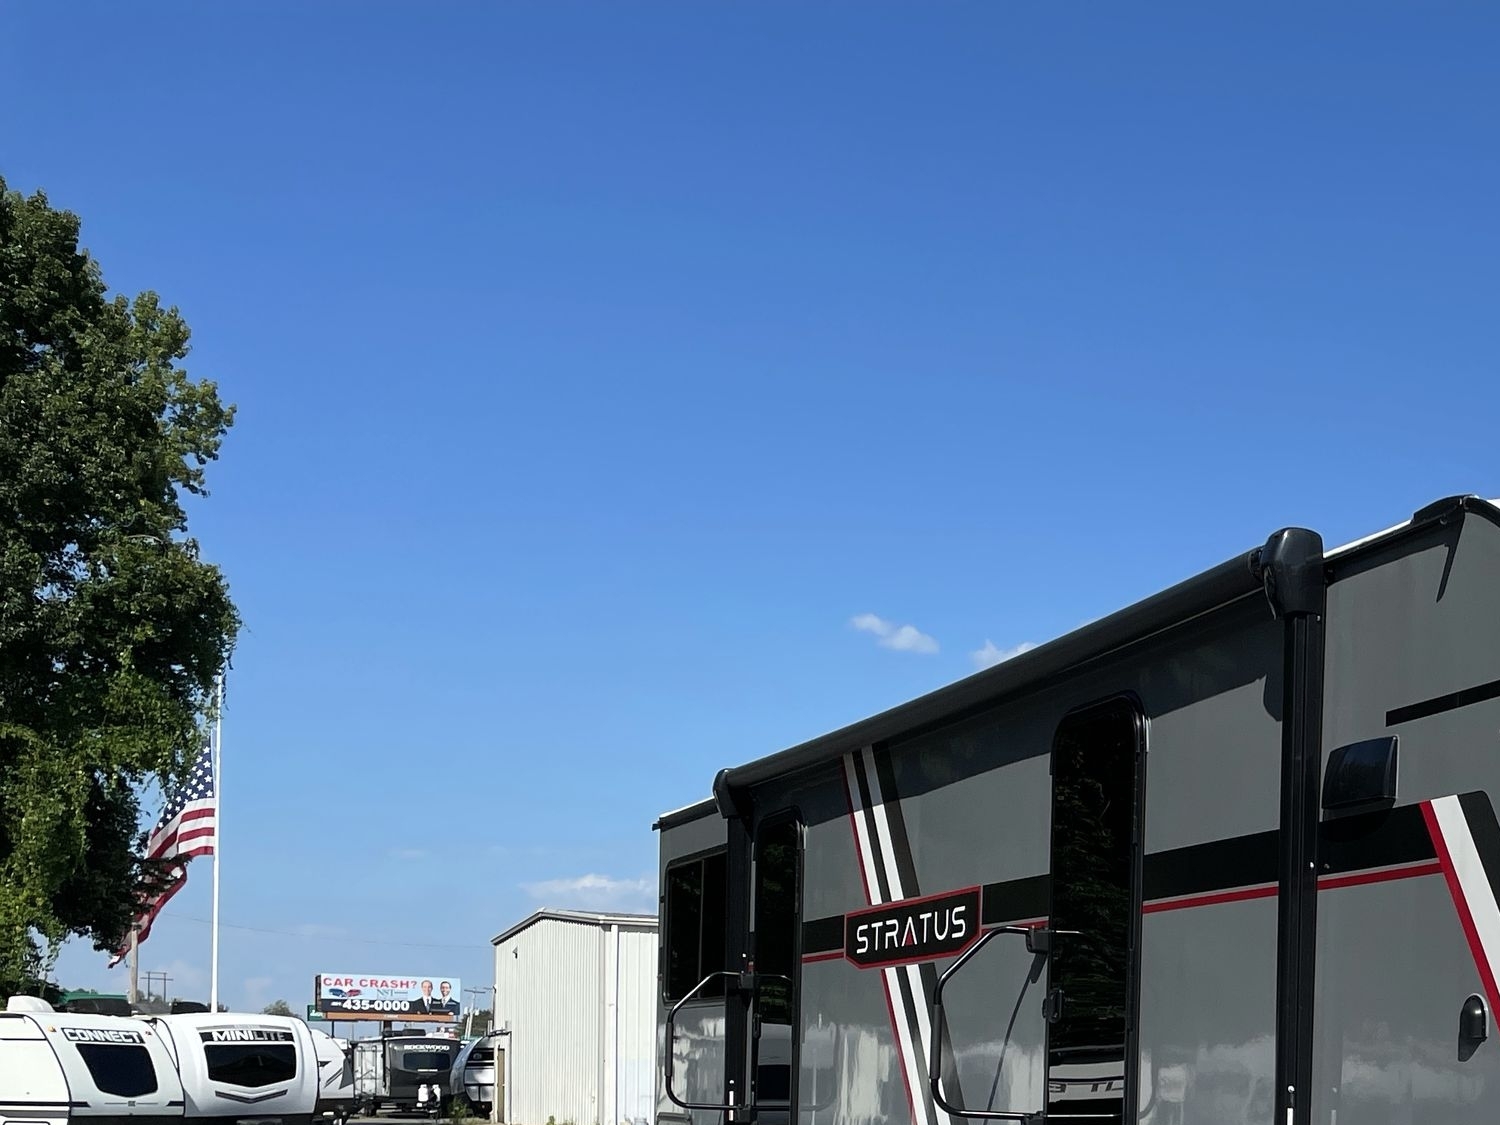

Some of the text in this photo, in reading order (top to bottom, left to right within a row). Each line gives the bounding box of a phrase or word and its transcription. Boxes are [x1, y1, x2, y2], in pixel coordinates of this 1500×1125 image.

[856, 905, 966, 954] STRATUS
[323, 977, 418, 989] CAR CRASH?
[342, 999, 410, 1012] 435-0000
[66, 1028, 140, 1044] CONNECT
